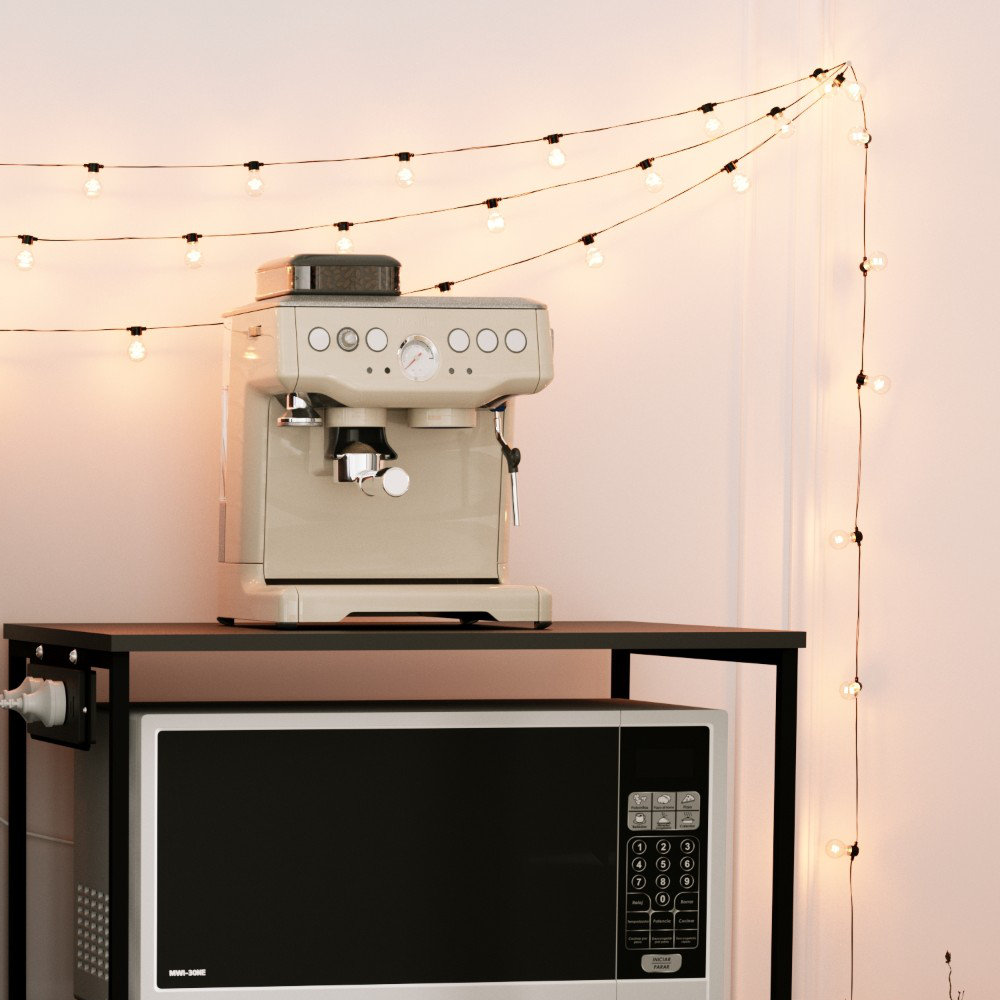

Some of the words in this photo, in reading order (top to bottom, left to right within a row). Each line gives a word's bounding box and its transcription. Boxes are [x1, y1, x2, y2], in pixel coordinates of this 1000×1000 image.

[637, 843, 642, 851] 1
[660, 842, 667, 851] 2
[684, 842, 691, 851] 3
[636, 860, 642, 869] 4
[660, 860, 666, 869] 5
[684, 860, 690, 868] 6
[636, 878, 642, 886] 7
[660, 877, 666, 886] 8
[684, 877, 690, 886] 9
[659, 894, 666, 903] 0
